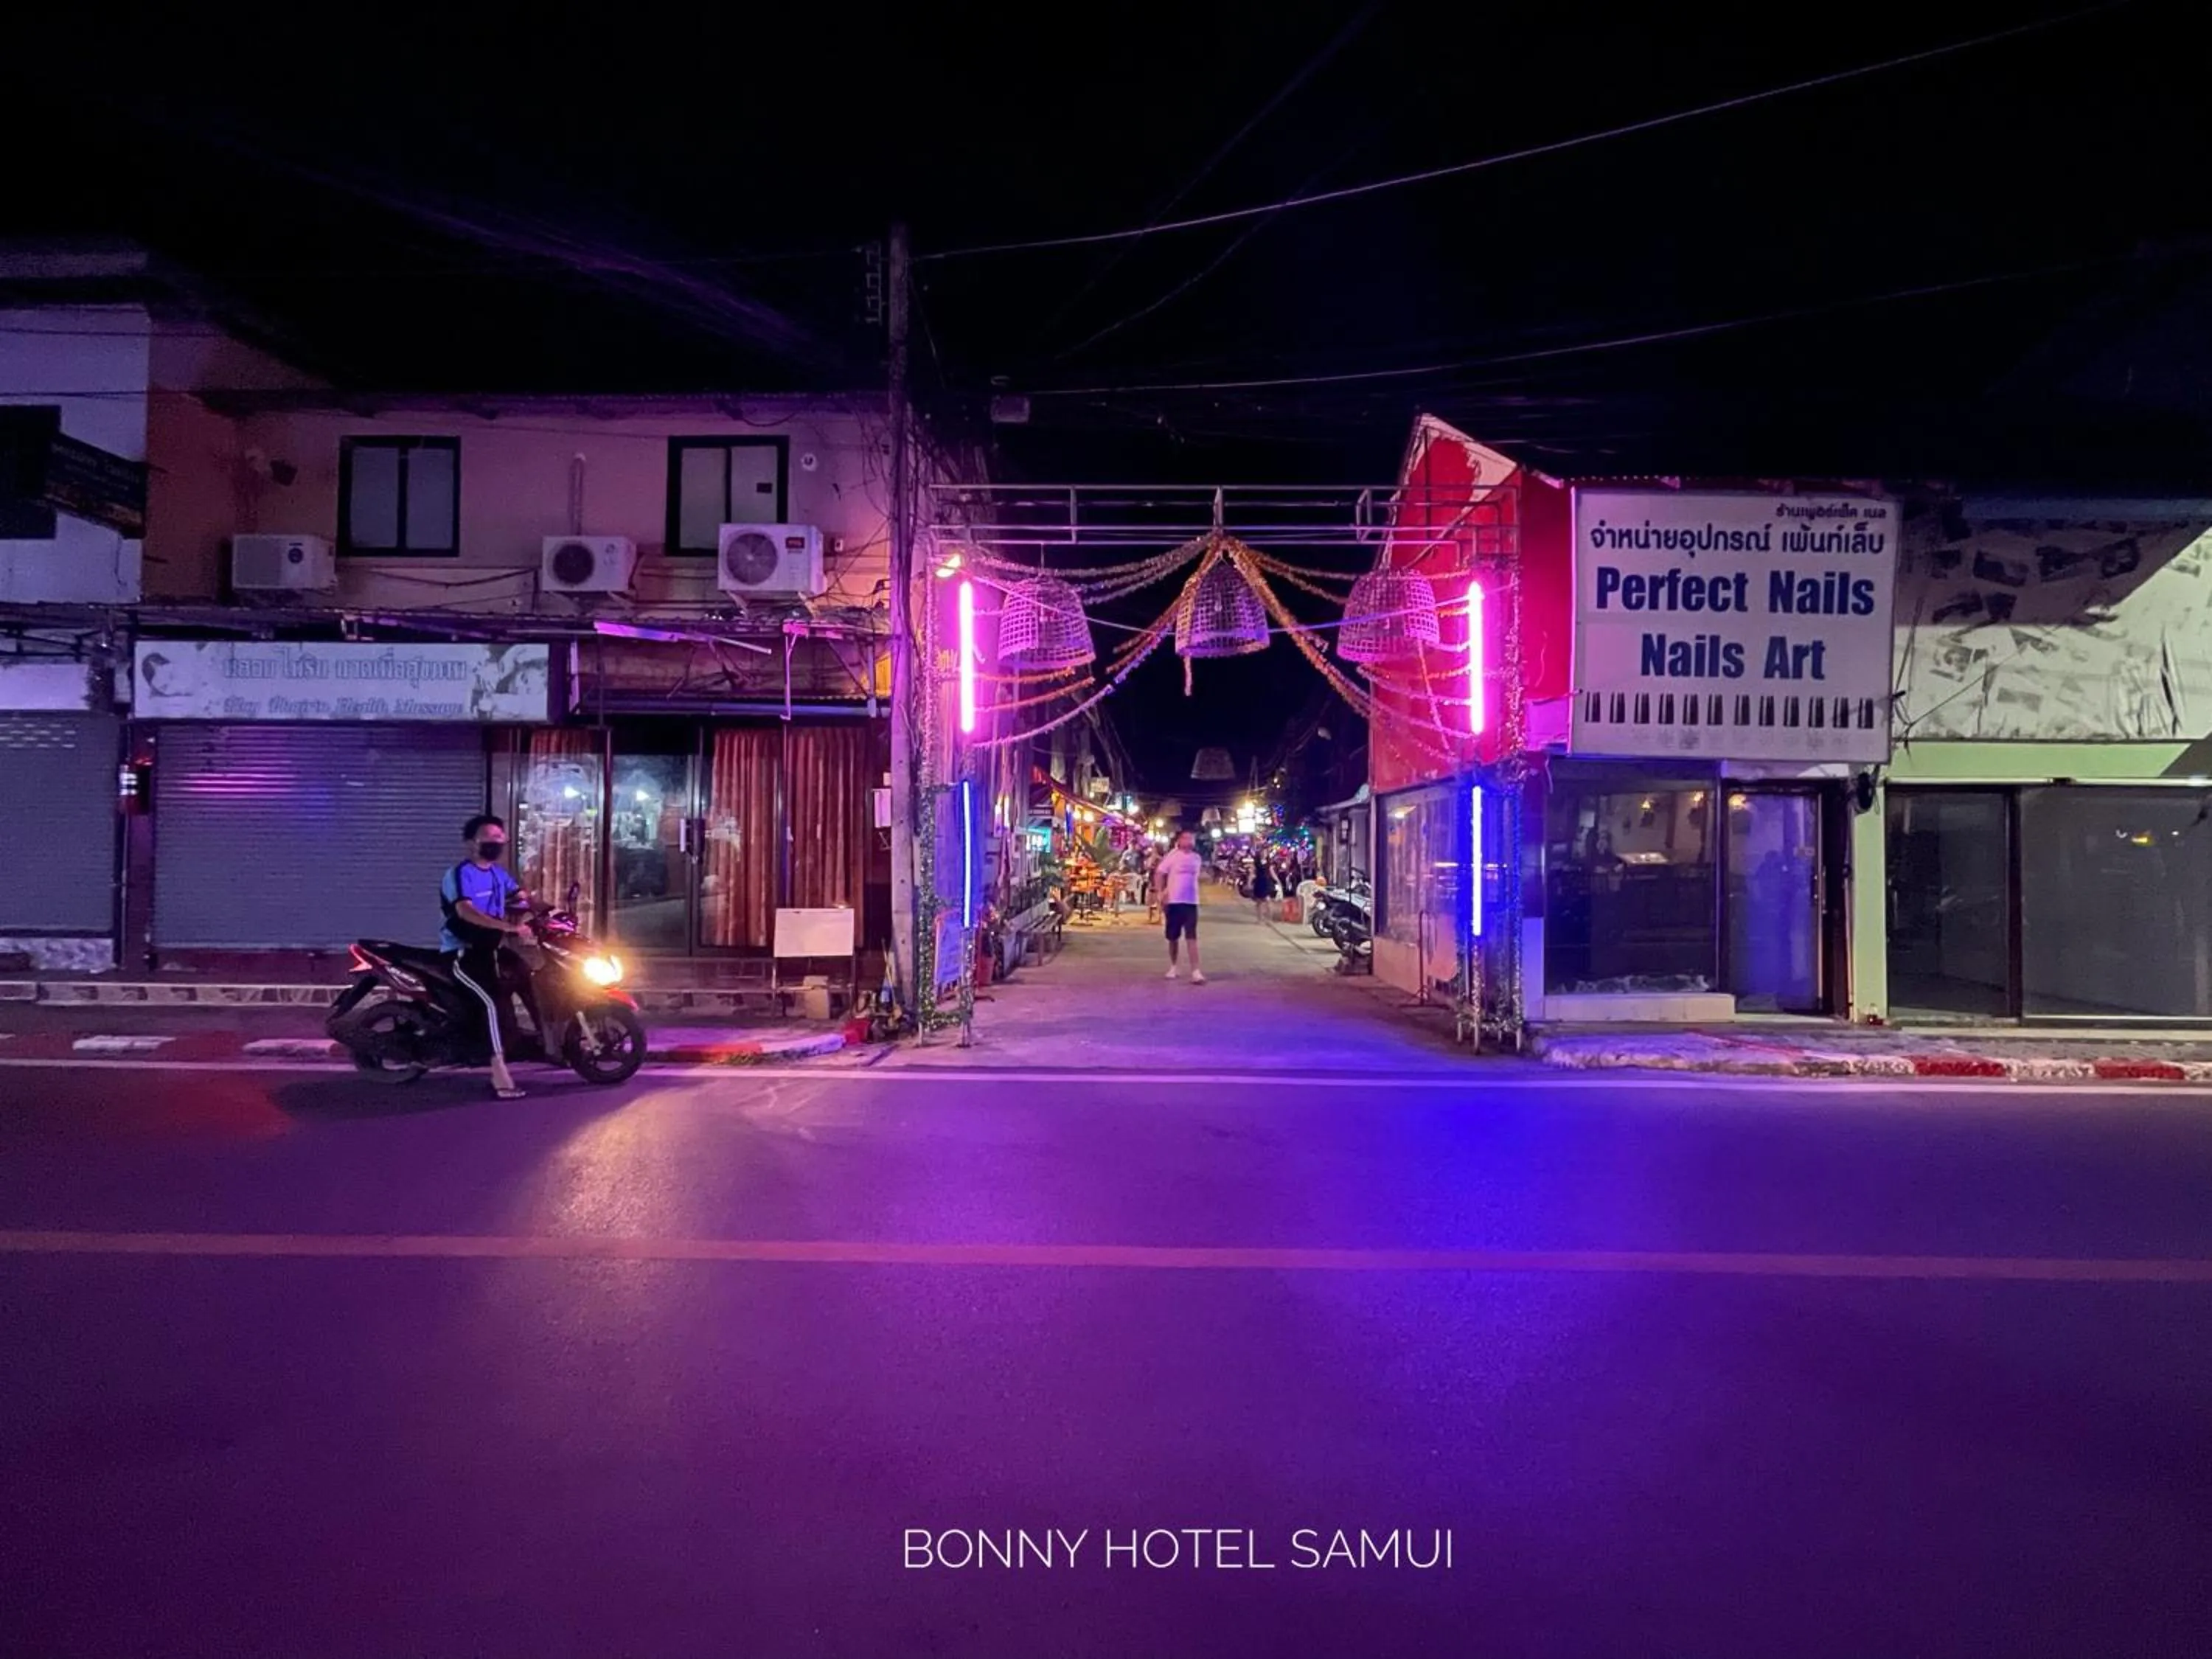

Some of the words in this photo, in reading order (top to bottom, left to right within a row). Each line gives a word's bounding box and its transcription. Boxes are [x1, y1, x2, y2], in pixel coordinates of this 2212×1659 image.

[1590, 519, 1772, 559] จำหน่ายอุปกรณ์
[1596, 566, 1748, 613] Perfect
[1770, 569, 1875, 616] Nails
[1641, 633, 1745, 679] Nails
[1763, 636, 1826, 681] Art
